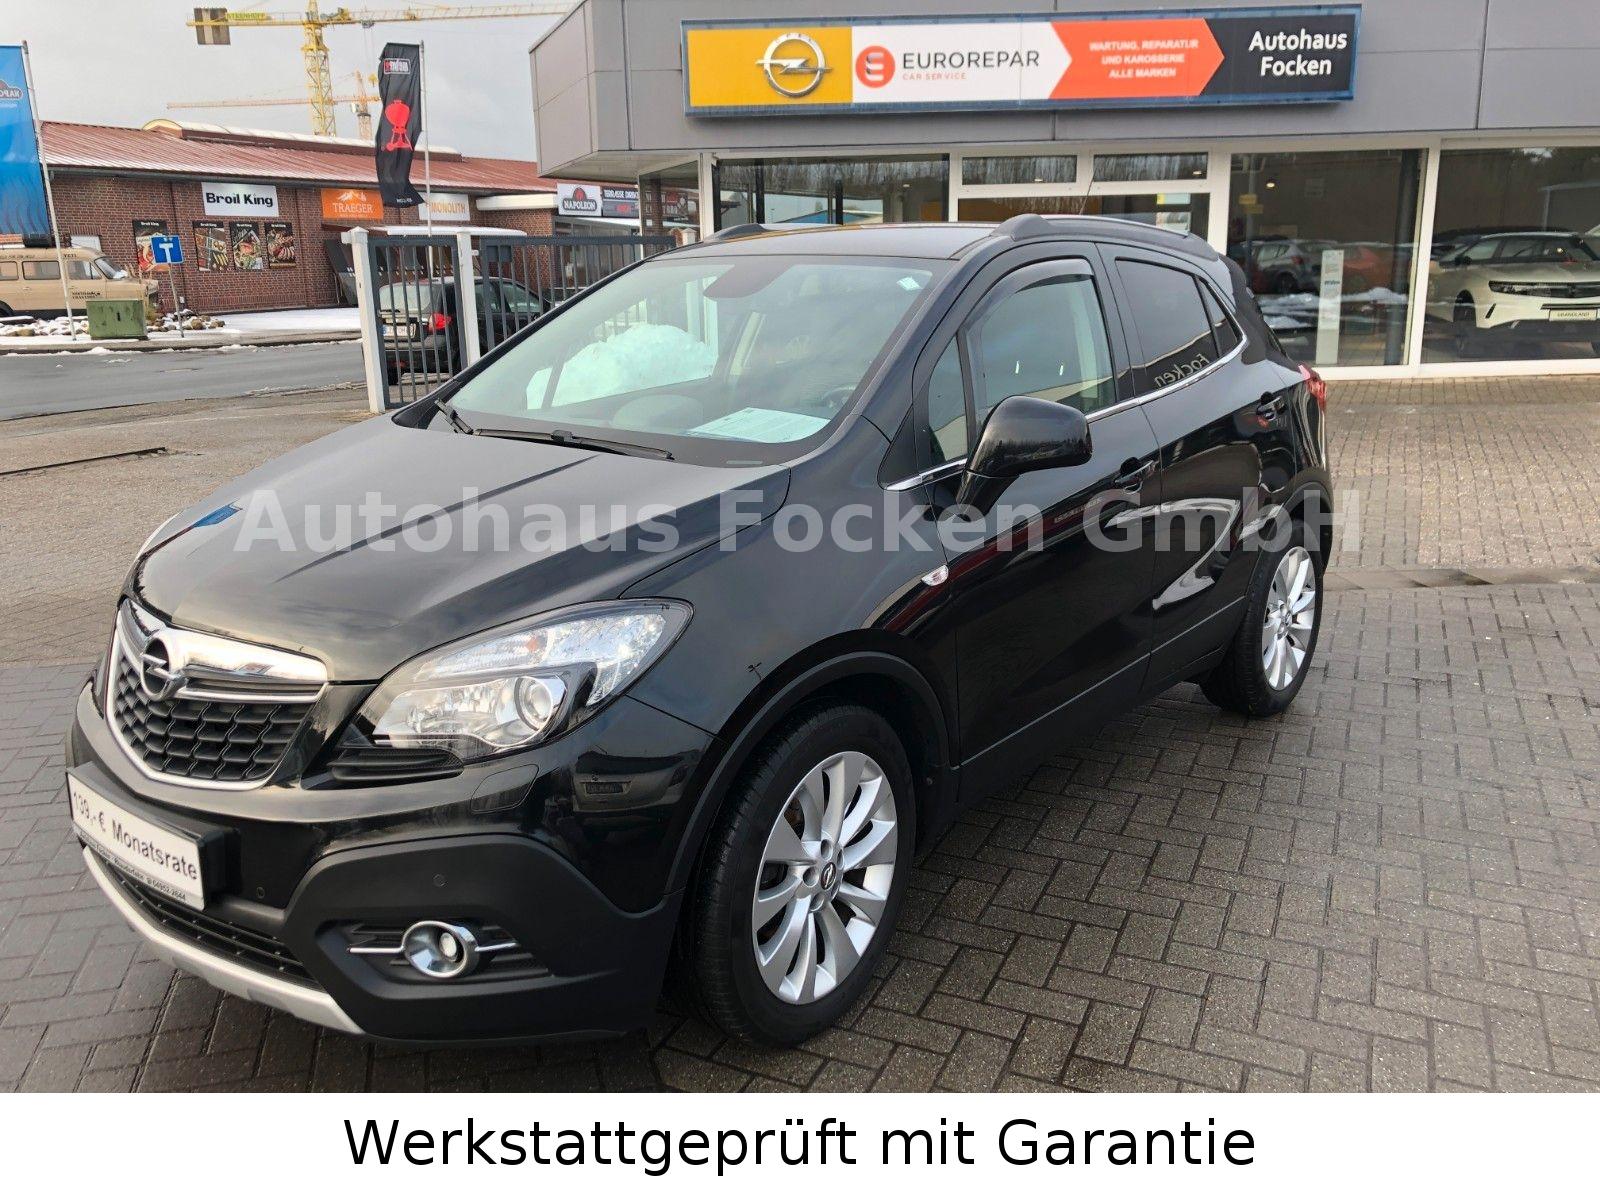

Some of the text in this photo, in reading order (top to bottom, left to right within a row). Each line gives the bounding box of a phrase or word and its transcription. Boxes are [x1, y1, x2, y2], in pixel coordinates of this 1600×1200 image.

[1142, 39, 1199, 49] REPARATUR
[1249, 28, 1347, 52] Autohaus
[903, 51, 1040, 69] EUROREPAR
[1102, 54, 1185, 65] UND KAROSSERIE
[1260, 54, 1332, 77] Focken
[902, 72, 967, 81] CAR SERVICE
[1108, 67, 1177, 78] ALLE MARKEN
[205, 192, 273, 208] Broil King
[563, 200, 596, 211] NAPOLEON
[332, 203, 374, 214] TRAEGER
[112, 819, 199, 880] Monatsrate
